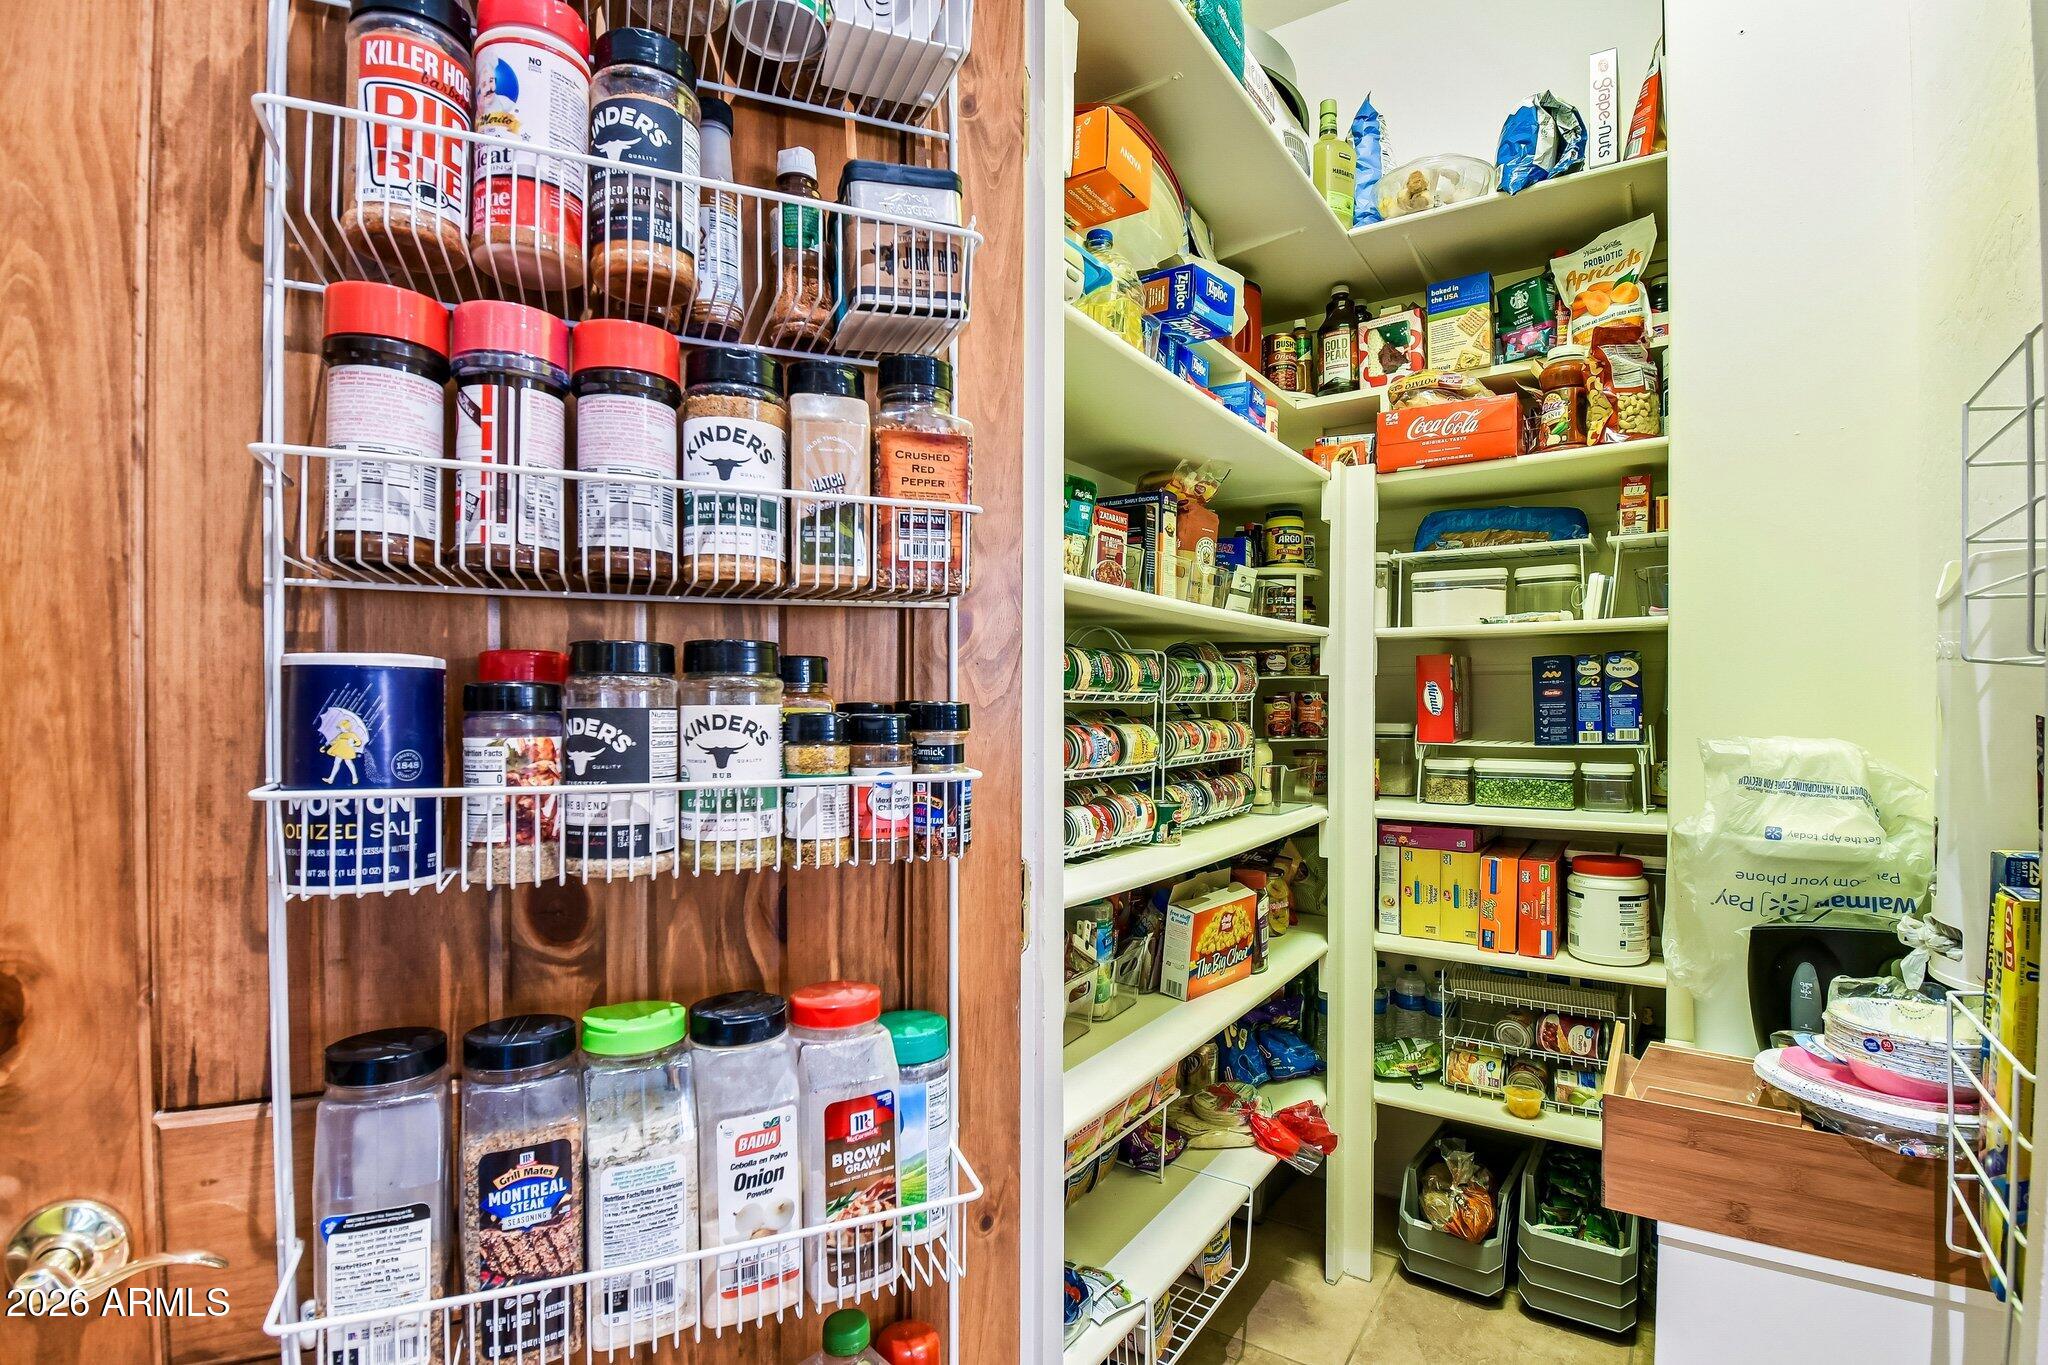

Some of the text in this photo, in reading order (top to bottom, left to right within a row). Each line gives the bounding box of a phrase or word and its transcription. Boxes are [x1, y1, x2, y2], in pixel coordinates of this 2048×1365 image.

[365, 39, 440, 80] KILLER
[528, 56, 542, 67] NO
[1593, 77, 1613, 159] grape-nuts
[592, 106, 672, 149] INDER'S
[627, 152, 658, 163] QUALITY
[1120, 146, 1142, 173] ANOVA
[879, 202, 937, 218] TRAEGER
[1584, 248, 1623, 269] PROBIOTIC
[1566, 248, 1643, 293] Apricots
[1174, 270, 1190, 310] Ziploc
[1207, 277, 1228, 303] Ziploc
[1431, 285, 1451, 297] baked
[1431, 293, 1459, 304] the USA
[1325, 338, 1348, 351] GOLD
[1325, 350, 1348, 362] PEAK
[1405, 379, 1437, 389] POTATO
[1386, 413, 1399, 422] 24
[1407, 408, 1484, 440] Coca-Cola
[686, 425, 776, 464] KINDER'S
[1422, 438, 1448, 446] ORIGINAL
[895, 450, 950, 463] CRUSHED
[911, 464, 935, 474] RED
[810, 472, 845, 493] HATCH
[901, 476, 945, 488] PEPPER
[902, 514, 946, 525] KRKLAND
[1100, 510, 1128, 525] ZATARAIN'S
[1278, 535, 1300, 544] ARGO
[1427, 681, 1442, 716] Minute
[682, 713, 772, 747] KINDER'S
[651, 738, 674, 747] Calorie
[484, 749, 503, 758] Facts
[497, 774, 503, 784] 0
[1763, 778, 1849, 795] TO A PARTICIPATING STORE FOR
[699, 787, 749, 798] BUTTEY
[288, 796, 413, 817] MORON
[687, 797, 764, 808] GARLI & ERB
[285, 818, 422, 841] ODIZED SALT
[1787, 831, 1882, 846] Get the App today
[1735, 870, 1788, 884] phone
[1790, 876, 1830, 888] your
[1715, 888, 1917, 915] Walmar Pay
[2004, 905, 2014, 967] GLAD
[1196, 952, 1226, 979] The Big
[738, 1130, 778, 1152] BADIA
[846, 1127, 879, 1143] McCormick
[730, 1159, 757, 1171] Cebolla
[769, 1151, 788, 1162] Polvo
[831, 1140, 891, 1168] BROWN
[844, 1157, 882, 1175] GRAVY
[499, 1165, 554, 1187] Grill Mates
[733, 1166, 785, 1192] Onion
[487, 1177, 568, 1208] MONTREAL
[746, 1187, 774, 1199] Powder
[510, 1197, 547, 1215] STEAK
[507, 1211, 548, 1227] SEASONING
[334, 1256, 399, 1272] Nutrition Facts
